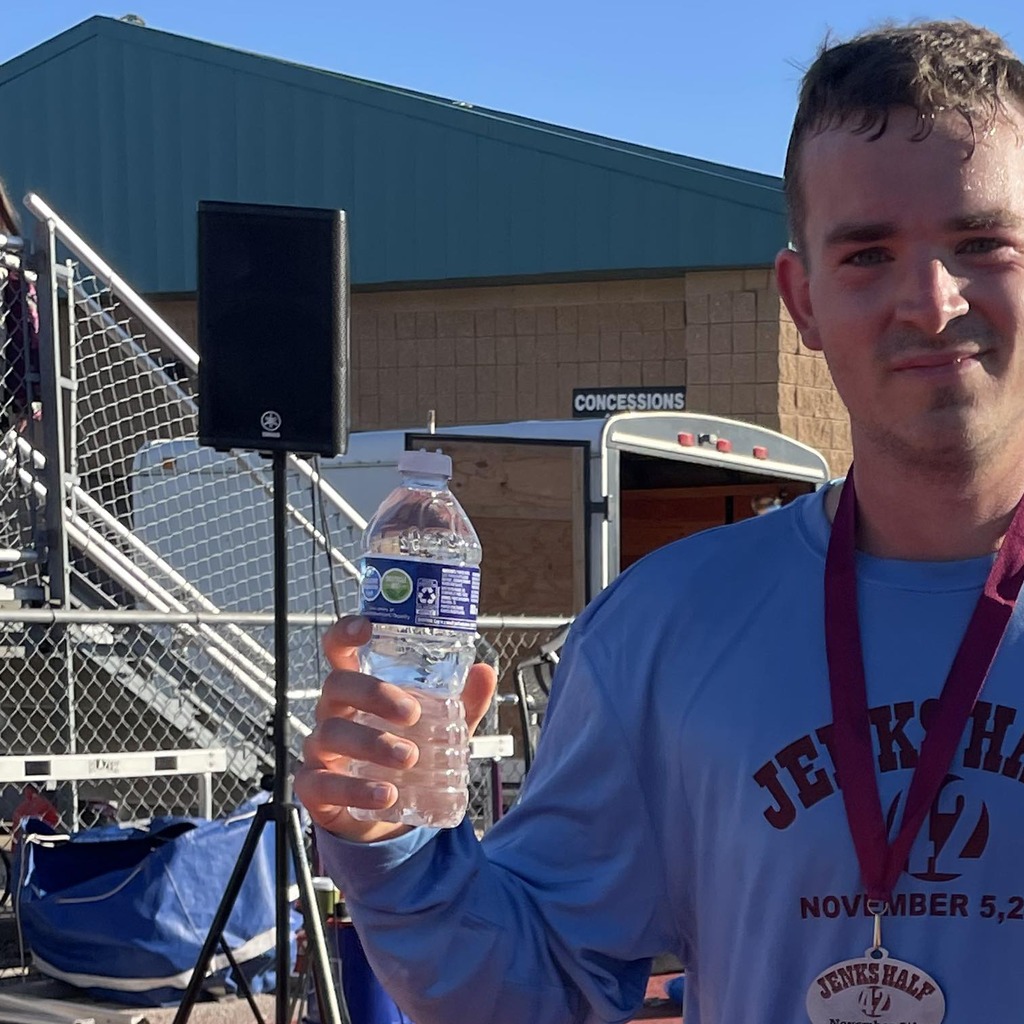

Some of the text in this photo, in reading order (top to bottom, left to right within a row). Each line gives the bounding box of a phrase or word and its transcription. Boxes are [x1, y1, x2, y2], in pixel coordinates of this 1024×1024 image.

[574, 392, 685, 412] CONCESSIONS
[816, 962, 936, 1002] JENKS HALF
